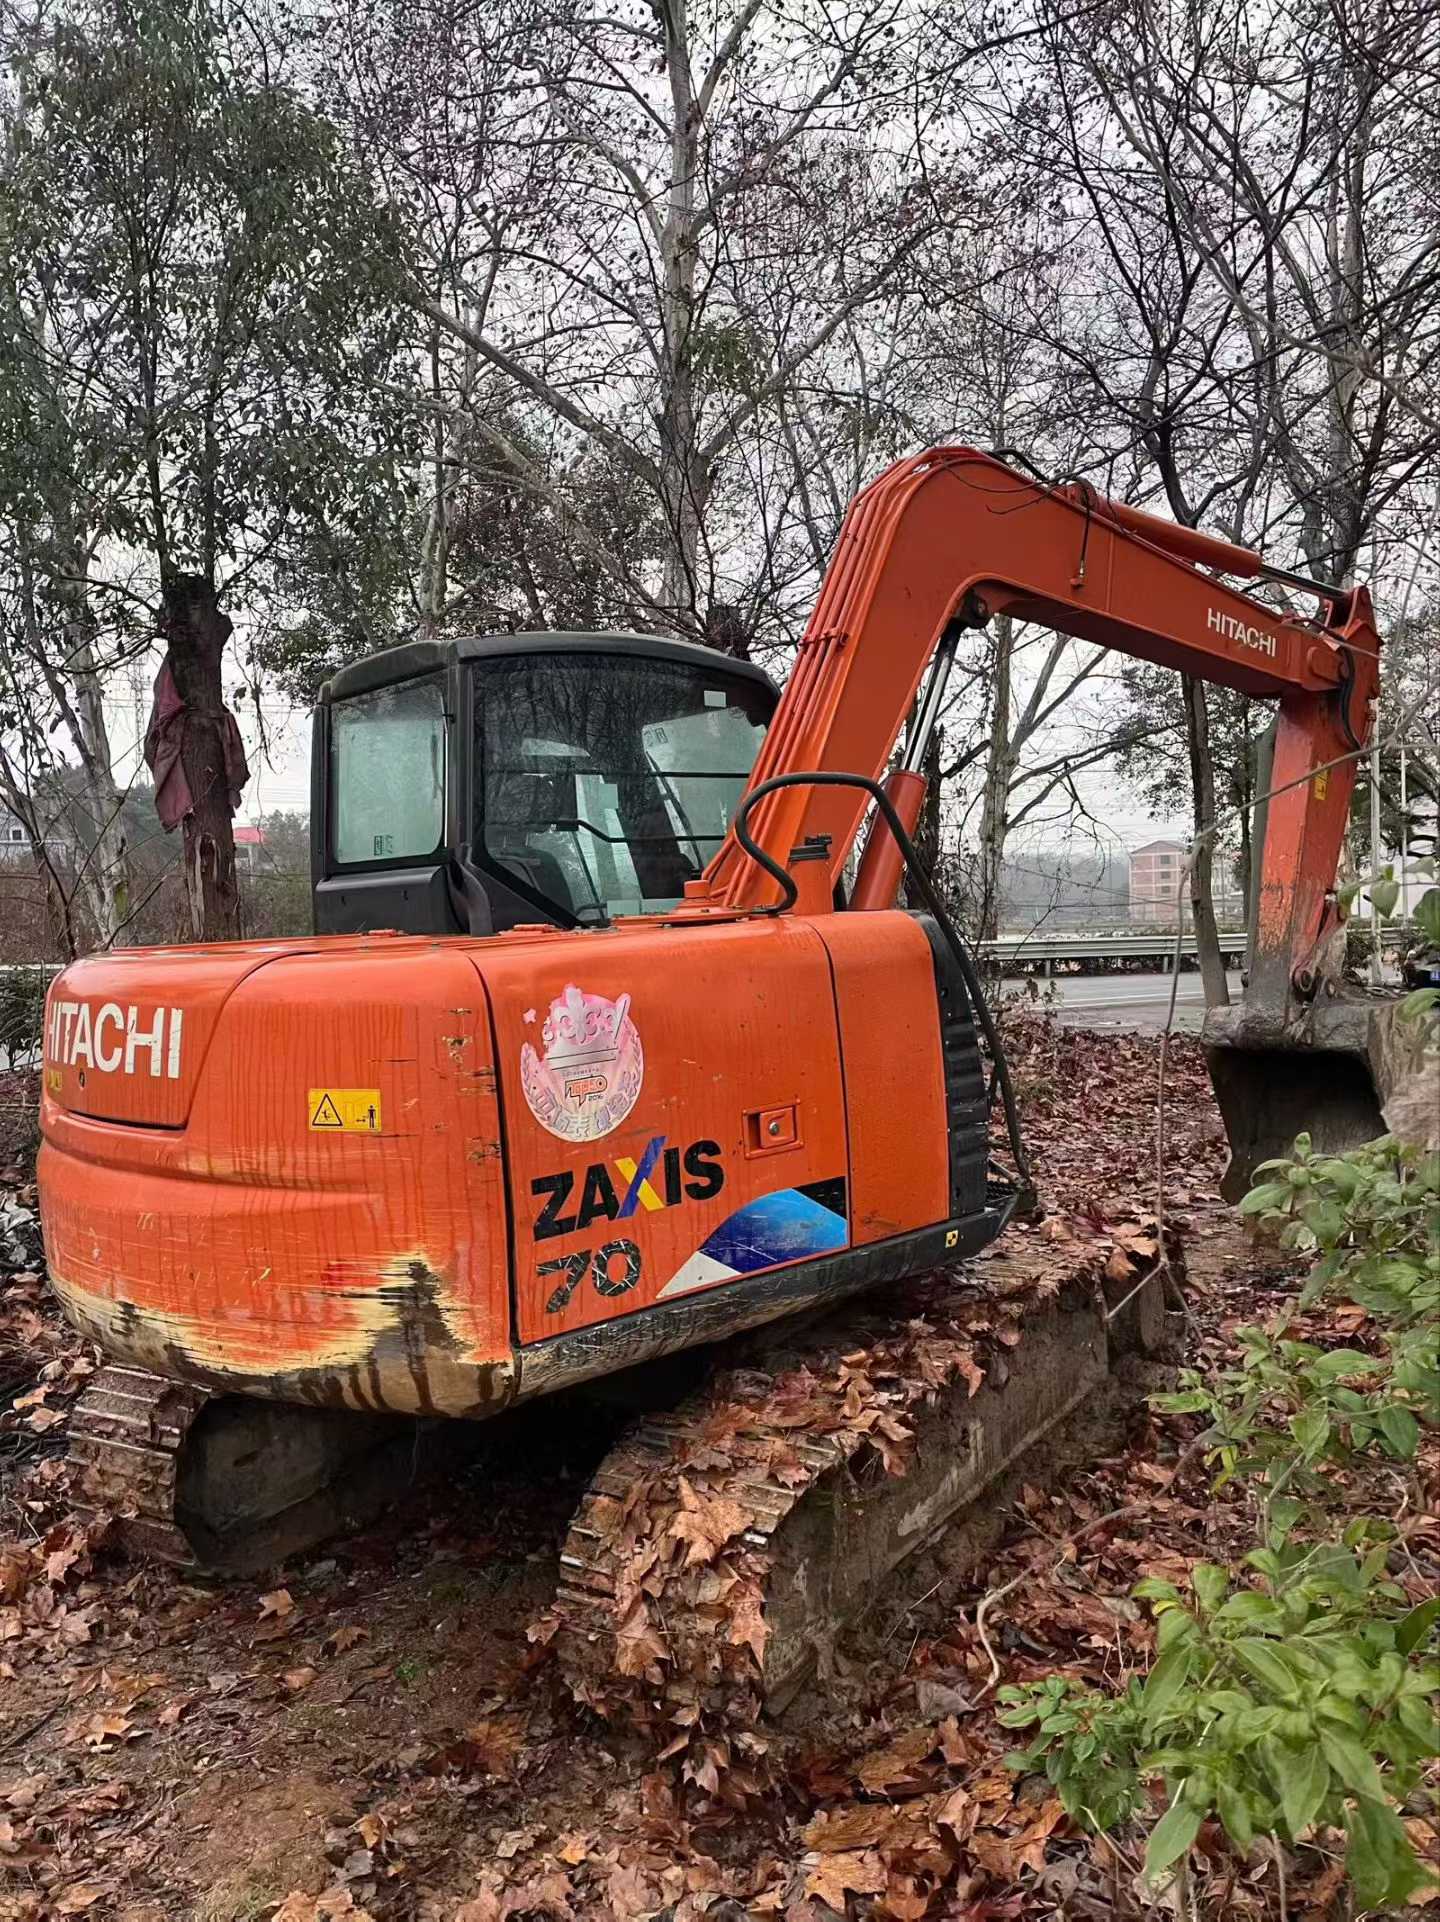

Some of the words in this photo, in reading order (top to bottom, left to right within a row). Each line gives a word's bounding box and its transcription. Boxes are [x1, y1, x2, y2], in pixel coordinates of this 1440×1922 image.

[1207, 607, 1277, 657] HITACHI
[47, 1001, 183, 1079] HITACHI
[531, 1135, 725, 1241] ZAXIS
[536, 1238, 642, 1313] 70
